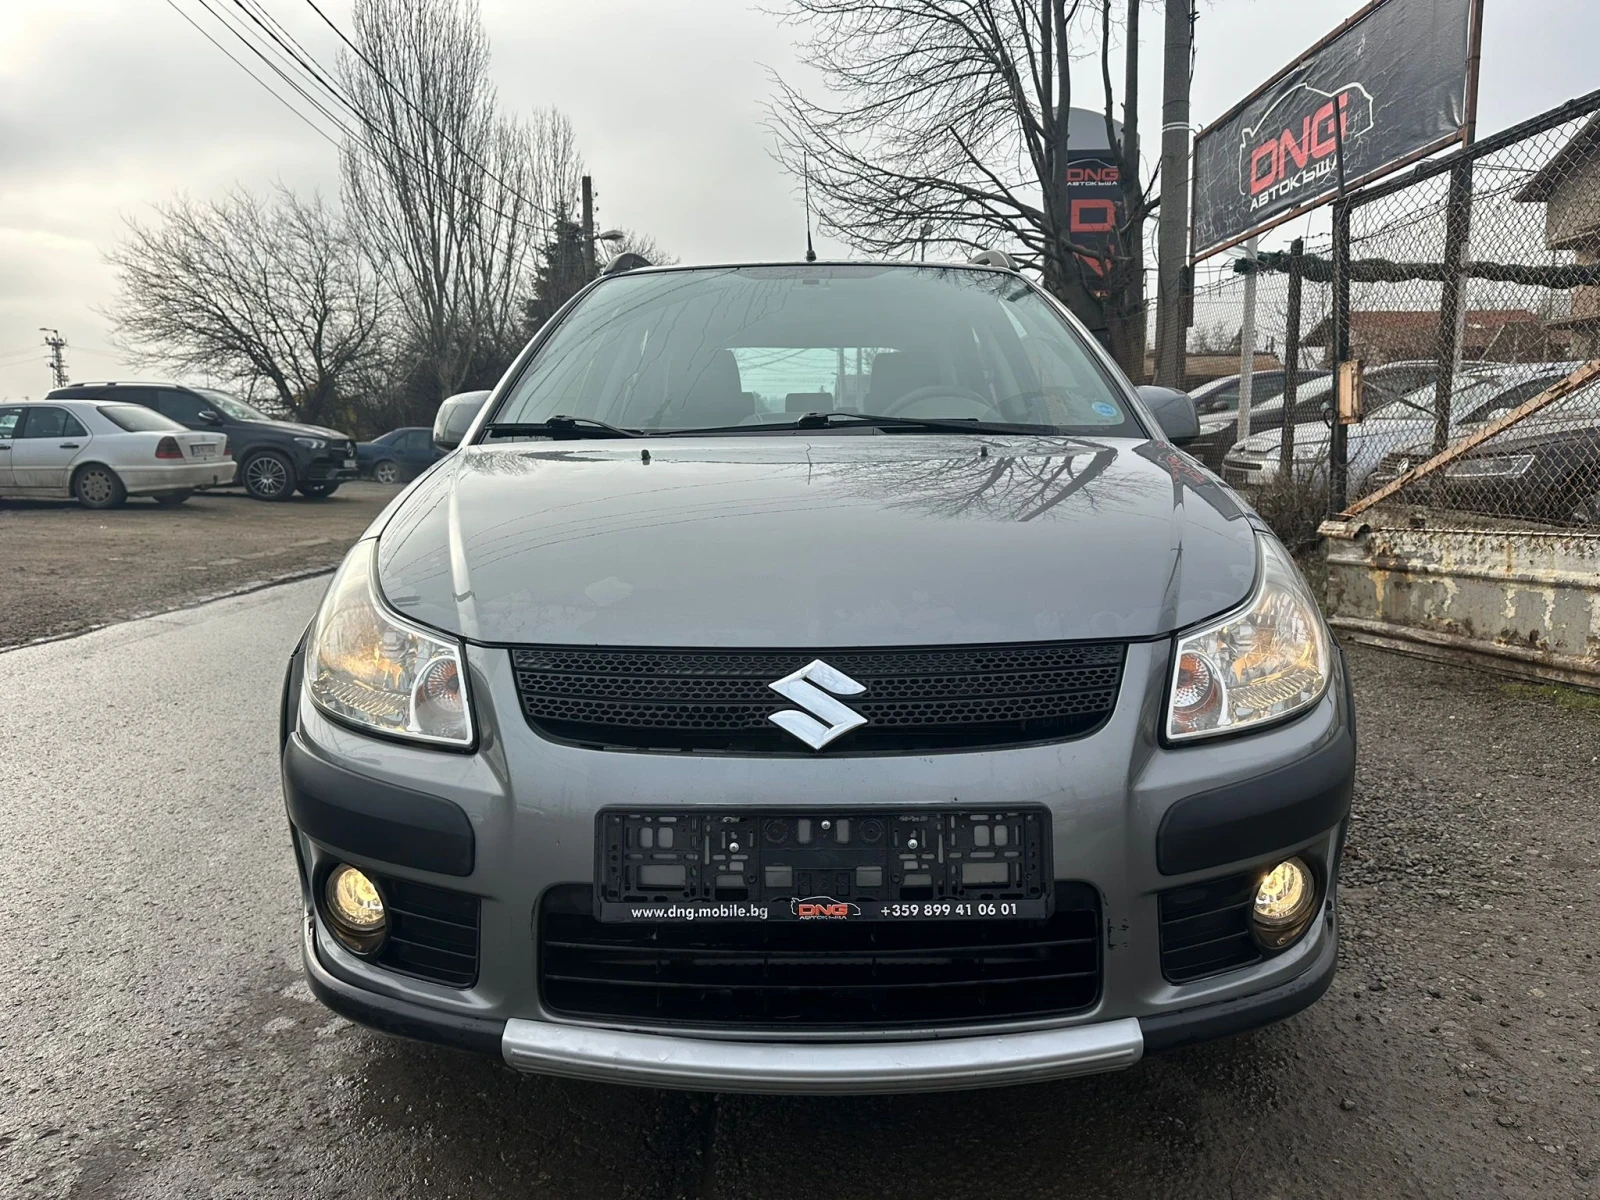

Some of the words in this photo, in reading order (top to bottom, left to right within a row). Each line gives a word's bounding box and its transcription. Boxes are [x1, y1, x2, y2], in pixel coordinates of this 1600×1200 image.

[1250, 91, 1349, 196] DNG
[1066, 168, 1119, 181] DNG
[631, 904, 768, 920] www.dng.mobile.bg
[798, 904, 848, 916] DNG
[880, 904, 919, 917] +359
[923, 904, 951, 916] 899
[955, 904, 972, 916] 41
[978, 903, 996, 916] 06
[1000, 903, 1017, 915] 01
